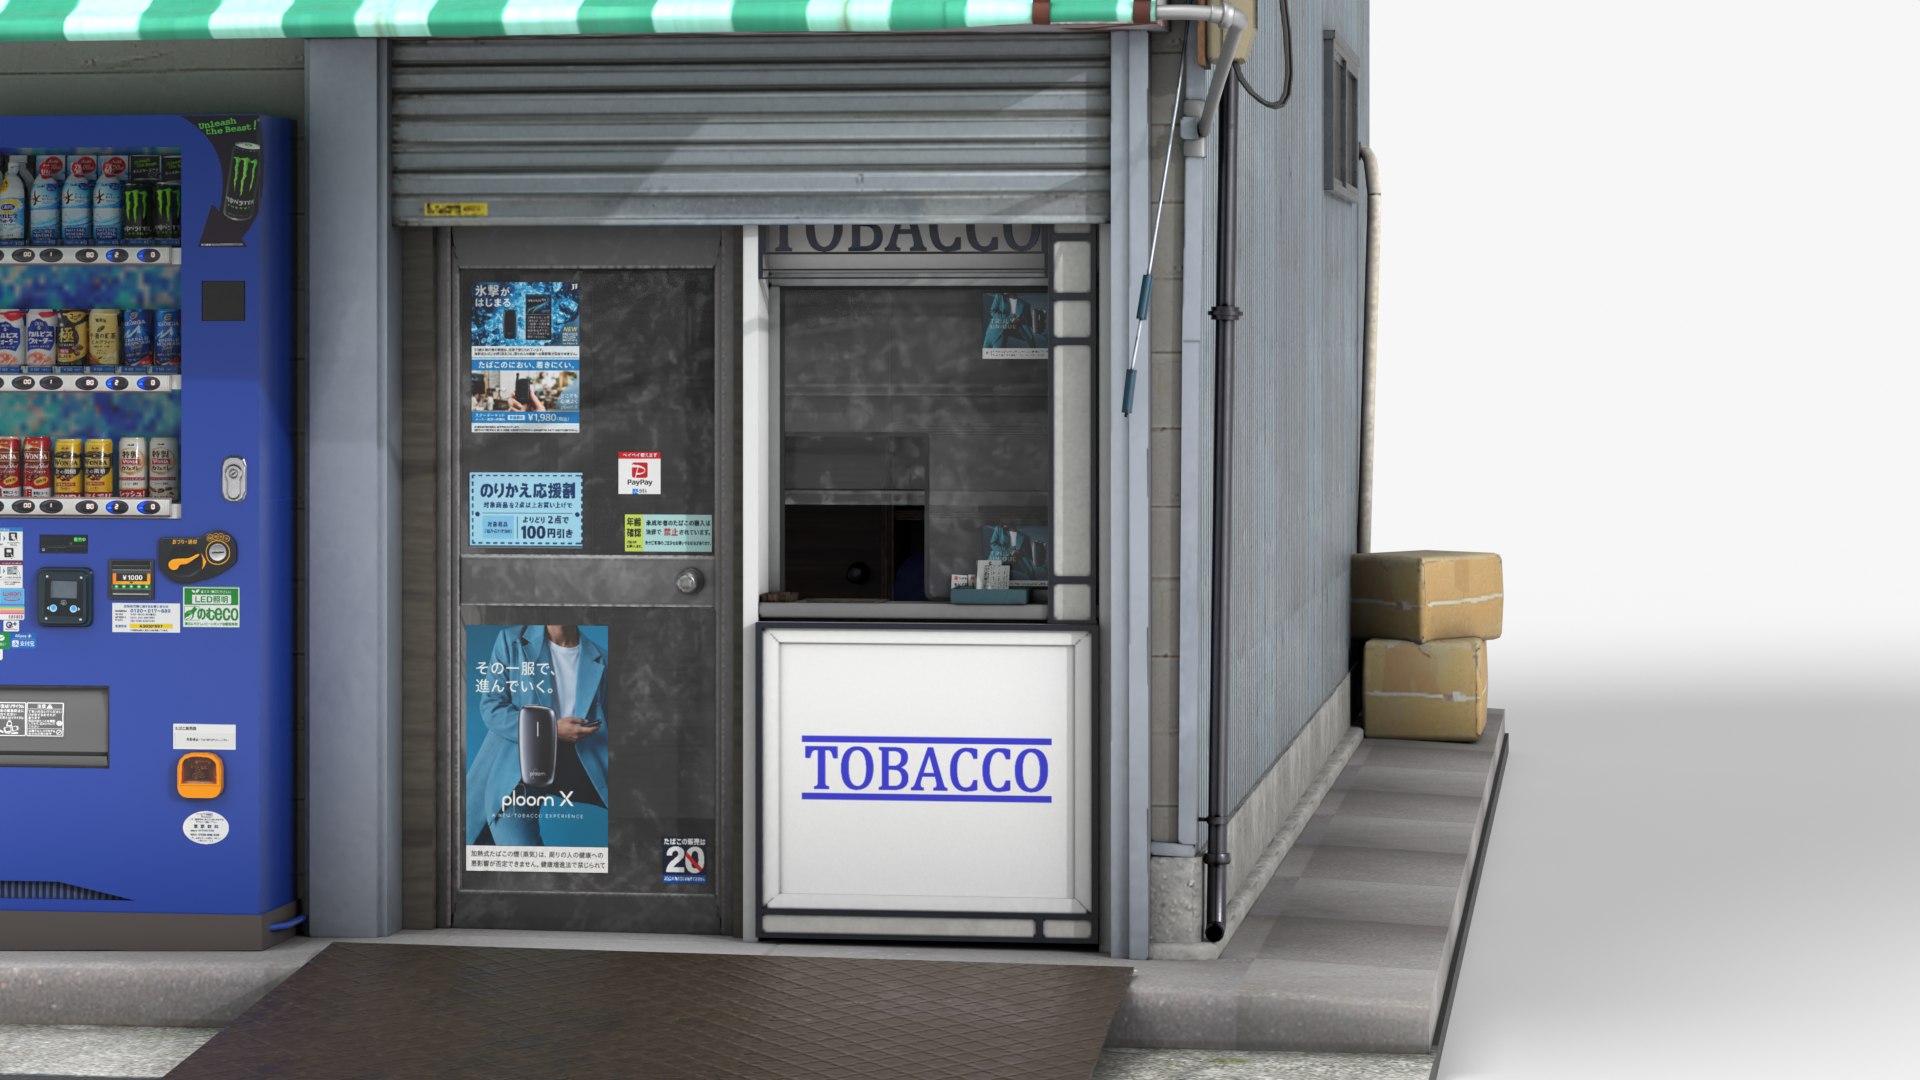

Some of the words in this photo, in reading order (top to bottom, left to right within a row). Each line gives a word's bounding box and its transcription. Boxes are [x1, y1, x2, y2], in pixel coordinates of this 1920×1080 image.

[198, 118, 237, 129] Unleash
[475, 285, 513, 296] 氷撃が、
[475, 298, 515, 307] はじまる。
[528, 414, 556, 423] ¥1,980
[627, 479, 653, 487] PayPay
[480, 482, 576, 499] のりかえ応援割
[627, 518, 641, 527] 年齢
[521, 526, 573, 539] 100円引き
[627, 529, 641, 537] 確認
[197, 608, 238, 621] のむeco
[475, 661, 556, 676] その一服で、
[475, 679, 554, 694] 進んでいく。
[805, 745, 1049, 793] TOBACCO
[501, 790, 554, 812] ploom
[559, 791, 574, 807] X
[666, 845, 705, 874] 20
